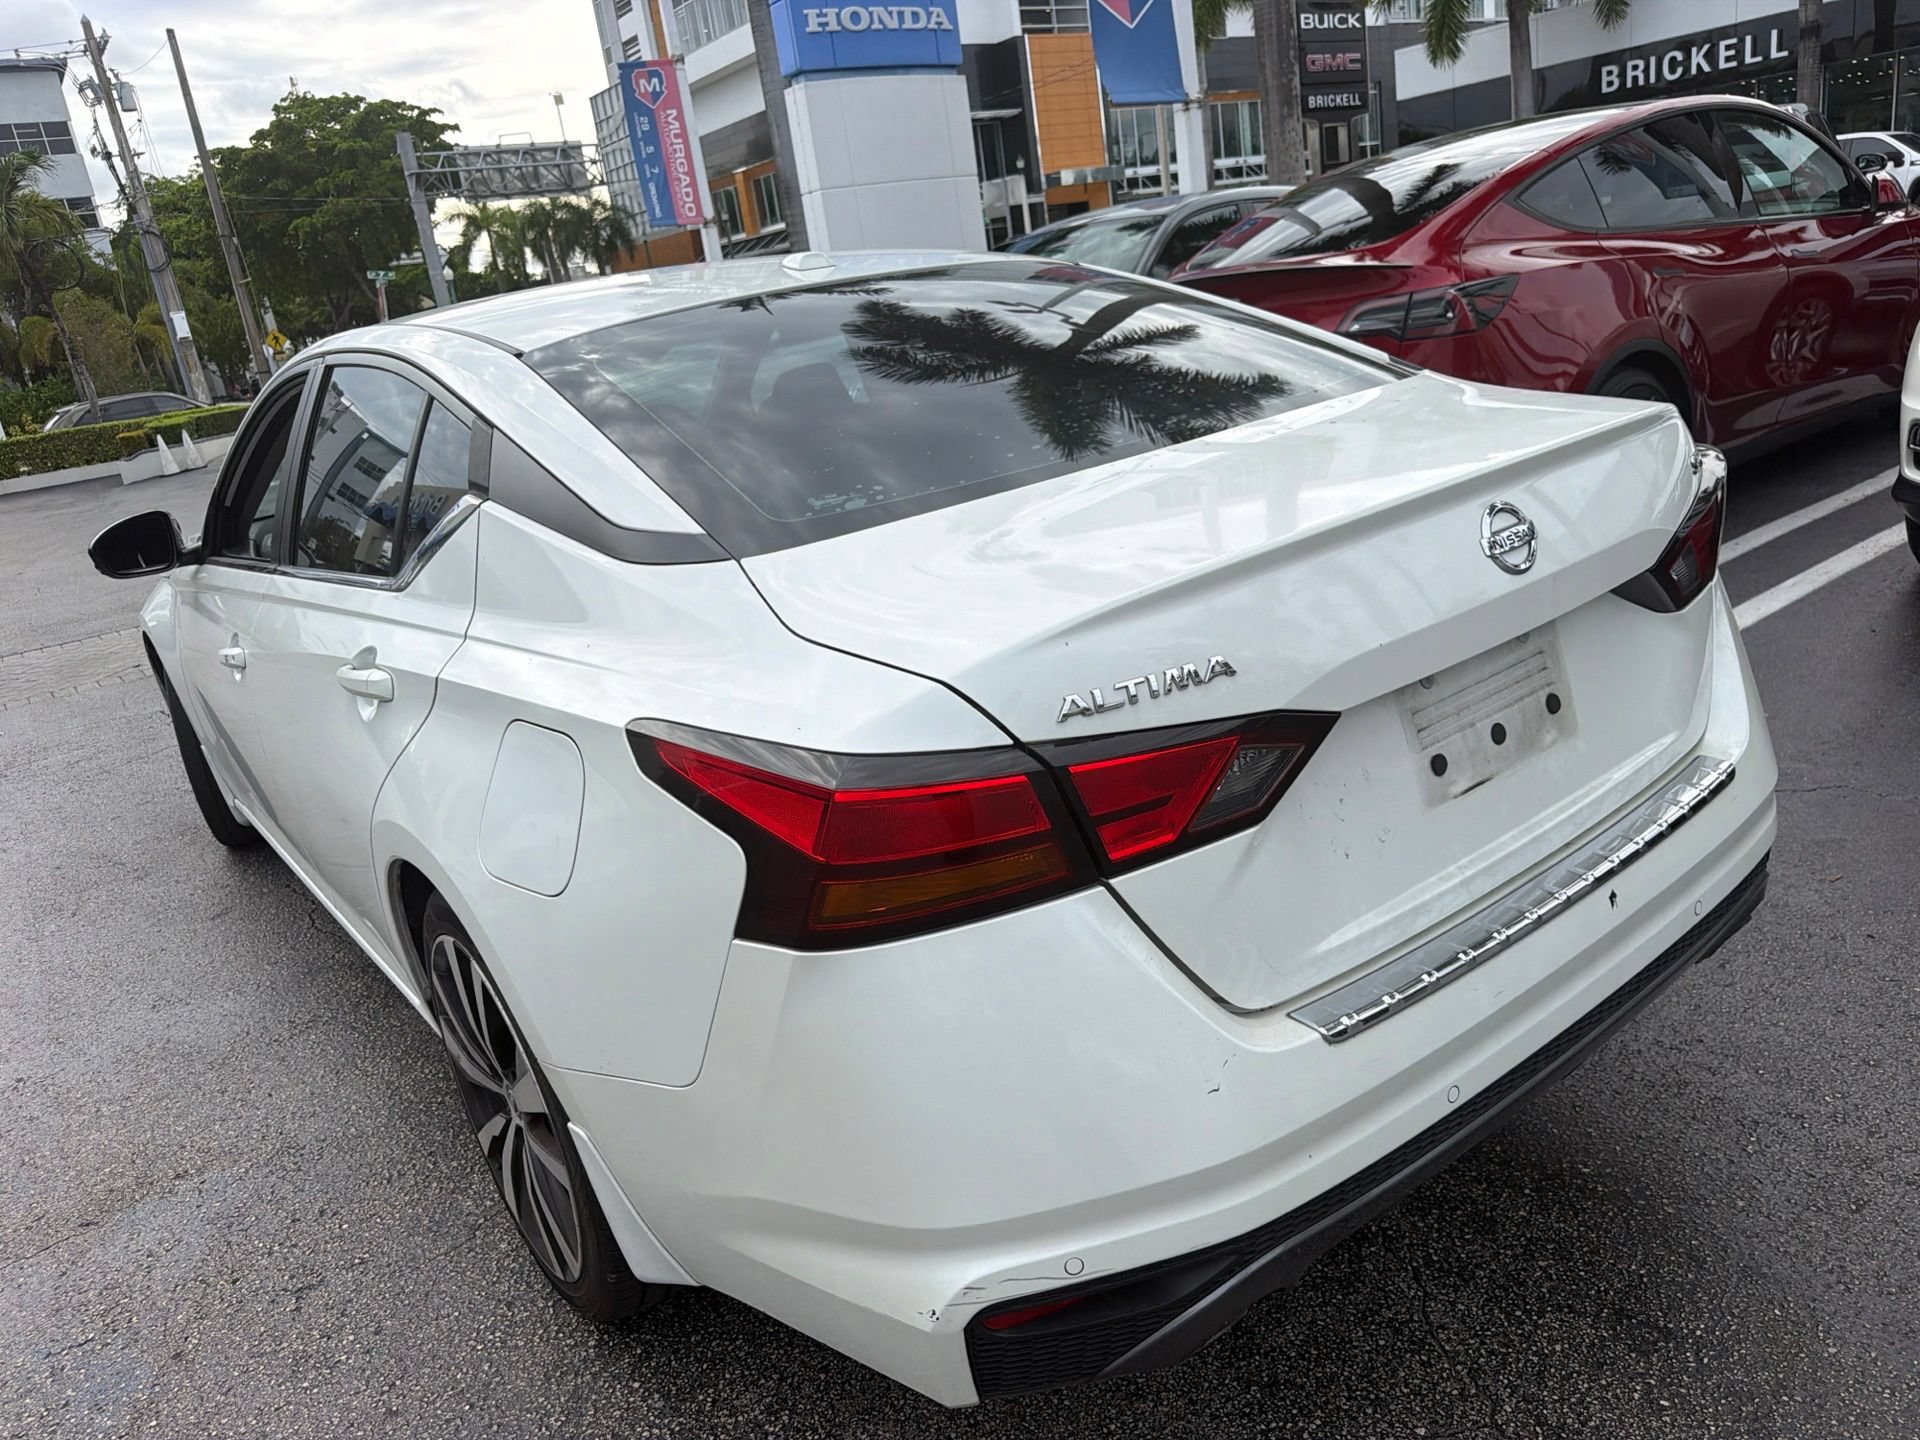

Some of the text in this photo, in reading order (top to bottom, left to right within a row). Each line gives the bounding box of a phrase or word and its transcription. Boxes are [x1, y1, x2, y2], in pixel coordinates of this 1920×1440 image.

[803, 6, 953, 33] HONDA
[1300, 13, 1362, 29] BUICK
[1306, 53, 1361, 71] GMC
[1601, 29, 1789, 94] BRICKELL
[640, 78, 660, 93] M
[1308, 93, 1362, 108] BRICKELL
[666, 109, 696, 217] MURGADO
[1491, 522, 1535, 551] NISSAN
[1057, 655, 1237, 723] ALTIMA
